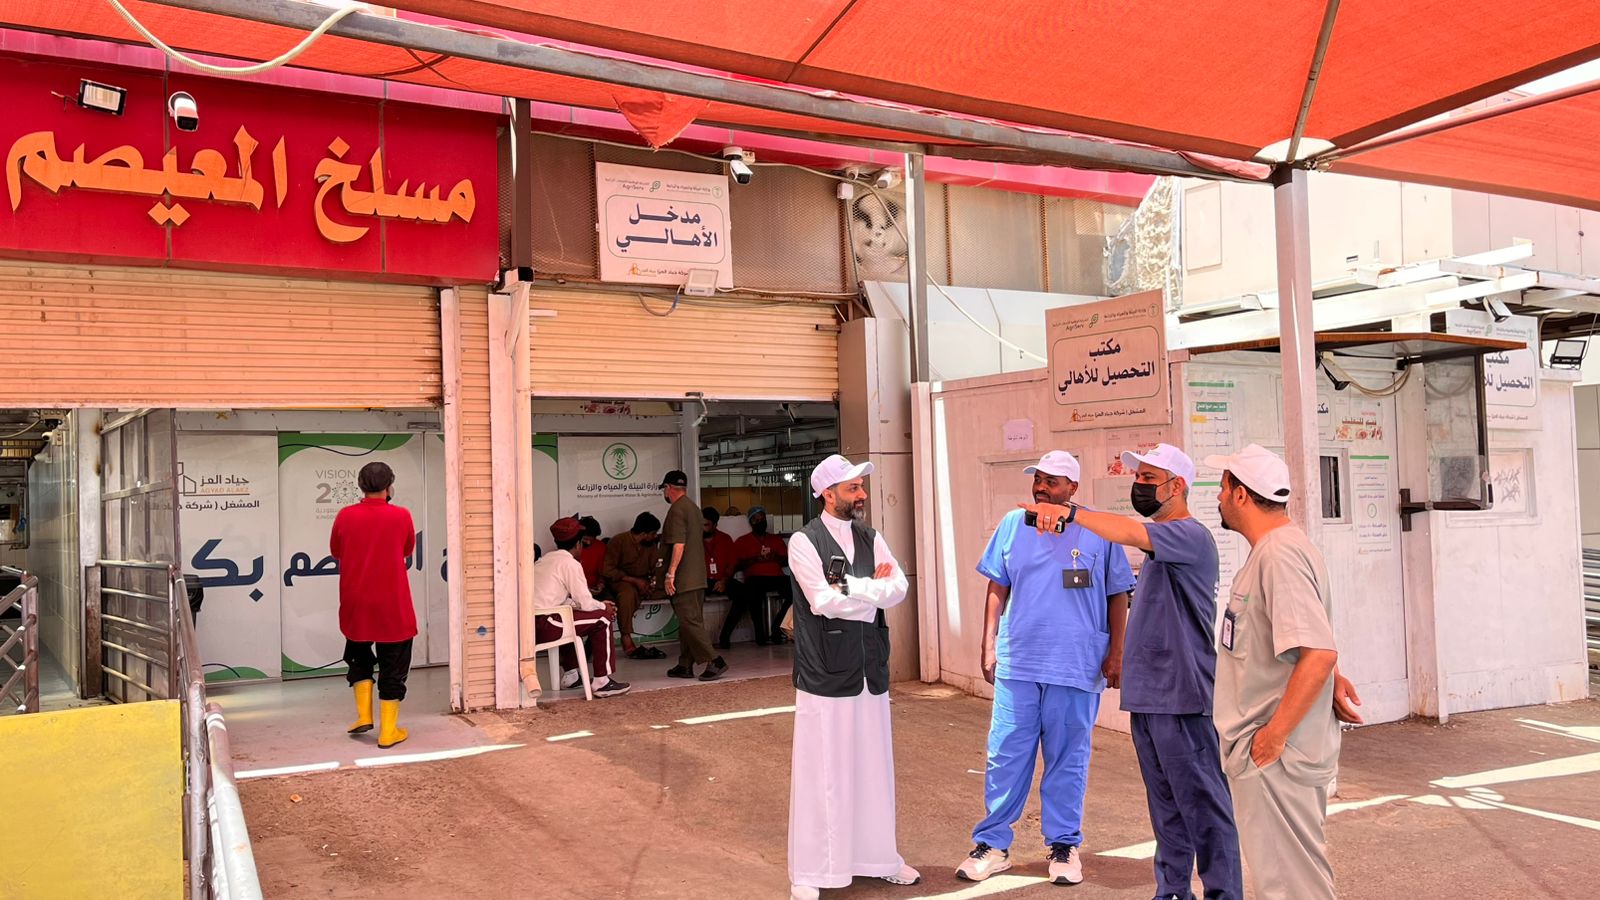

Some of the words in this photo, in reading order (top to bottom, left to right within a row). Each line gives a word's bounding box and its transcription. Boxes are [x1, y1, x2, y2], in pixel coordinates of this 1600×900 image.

[6, 125, 288, 226] المعيصم
[314, 136, 475, 243] مسلخ
[629, 203, 701, 225] مدخل
[616, 226, 718, 252] الأهالي
[1089, 338, 1121, 362] مكتب
[1058, 364, 1098, 396] للأهالي
[1102, 360, 1155, 386] التحصيل
[1496, 373, 1534, 392] التحصيل
[200, 474, 222, 487] العز
[225, 474, 249, 486] جياد
[314, 469, 357, 480] VISION
[577, 484, 602, 492] والزراعة
[603, 483, 627, 492] والمياه
[185, 500, 213, 512] شركة
[220, 499, 260, 511] المشغل
